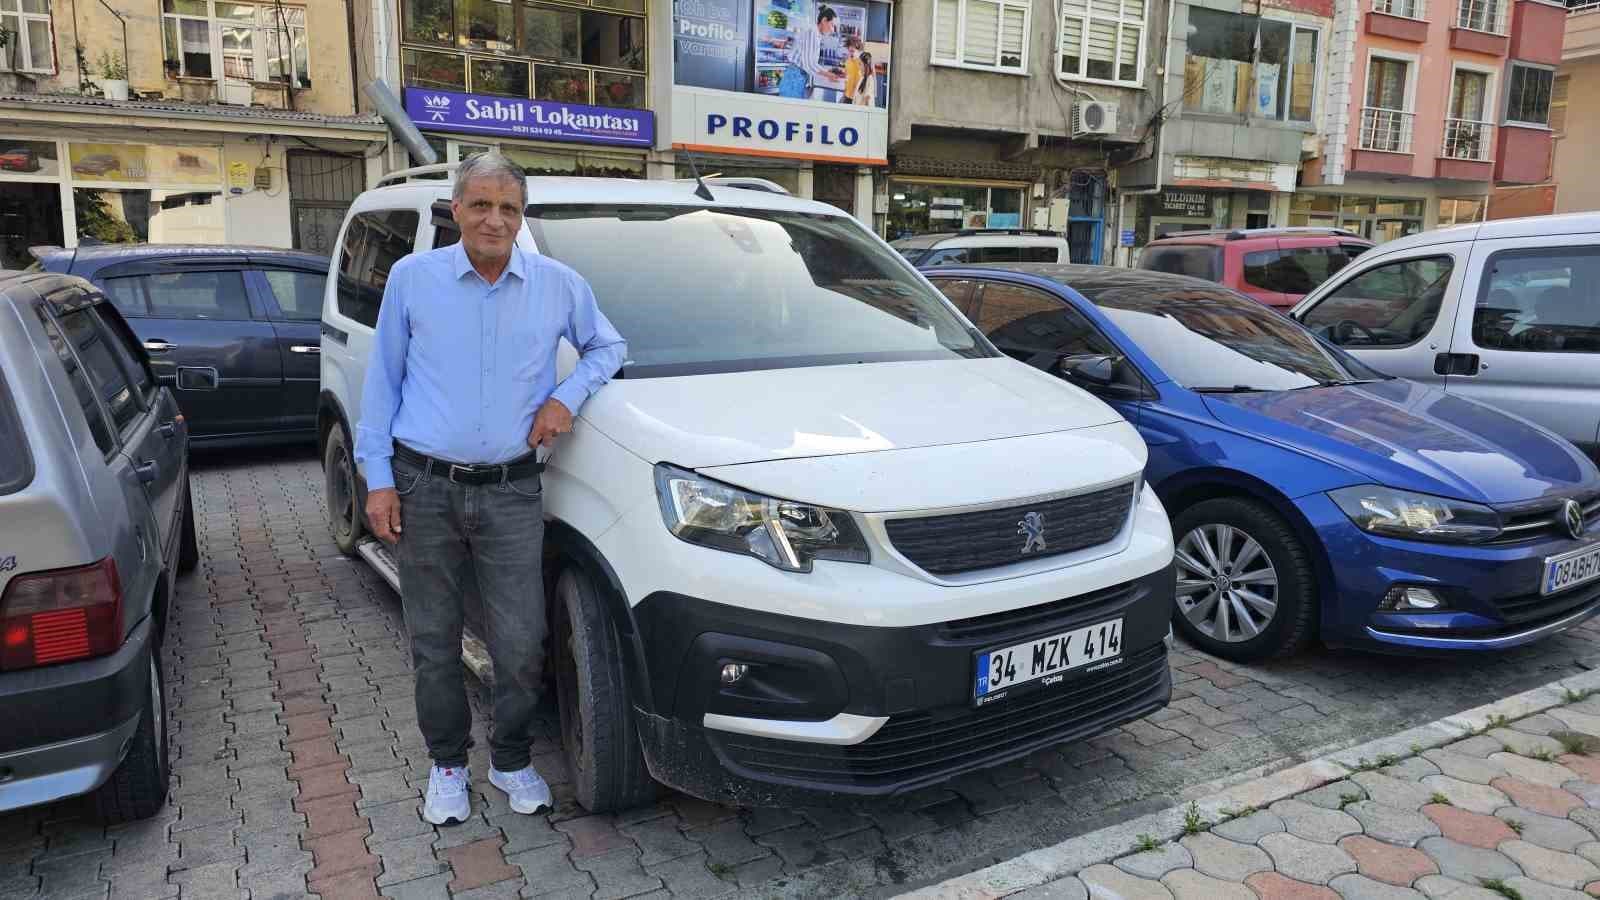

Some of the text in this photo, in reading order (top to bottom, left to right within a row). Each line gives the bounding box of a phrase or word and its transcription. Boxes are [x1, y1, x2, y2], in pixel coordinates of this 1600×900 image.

[680, 20, 734, 40] Profilo
[465, 99, 639, 132] Sahil Lokantası
[1165, 192, 1206, 204] YILDIRIM
[977, 624, 1119, 689] TR 34 MZK 414
